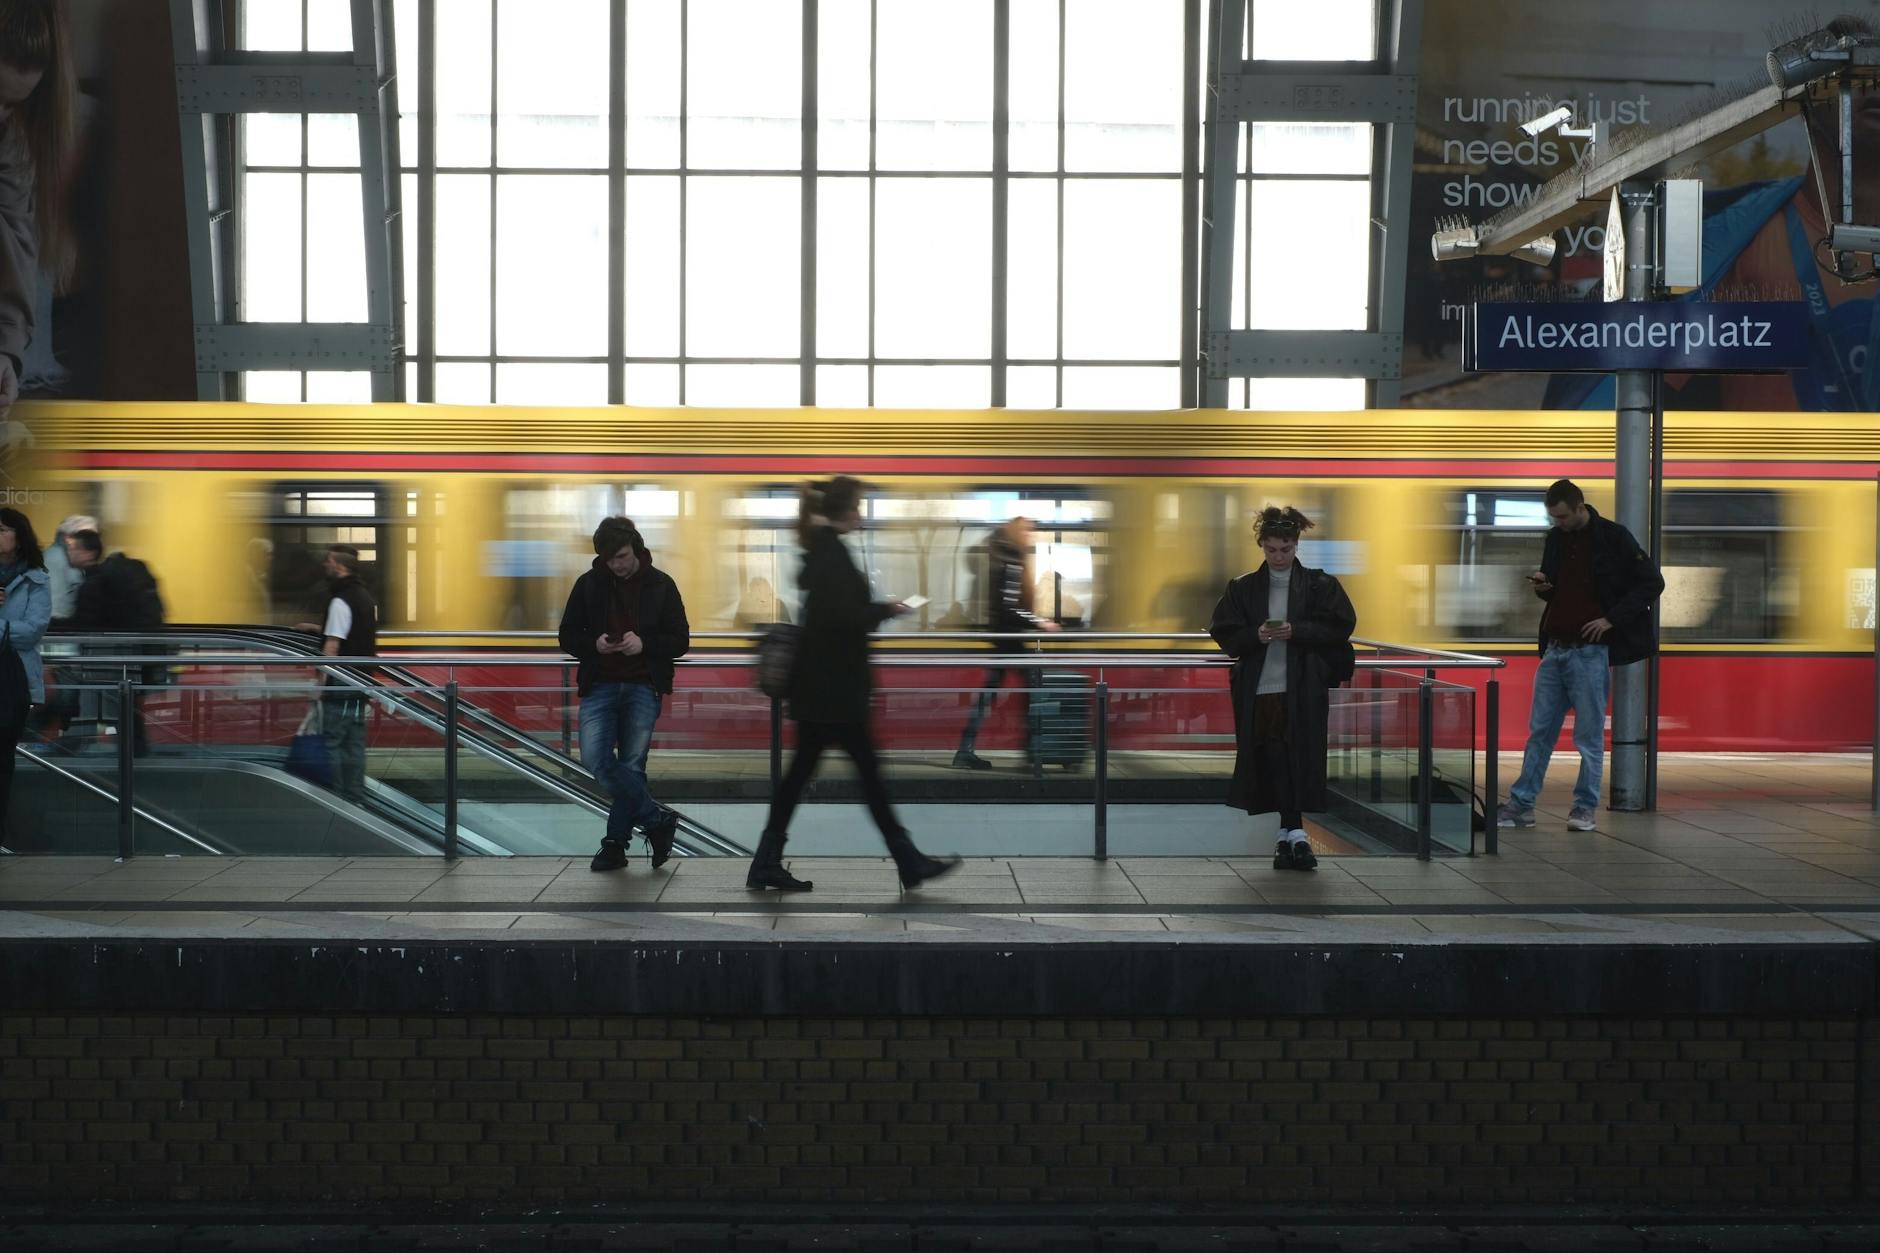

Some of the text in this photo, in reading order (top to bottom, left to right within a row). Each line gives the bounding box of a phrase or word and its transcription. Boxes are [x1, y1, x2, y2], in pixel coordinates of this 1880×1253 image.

[1586, 93, 1651, 127] just
[1443, 135, 1559, 166] needs
[1498, 315, 1773, 354] Alexanderplatz
